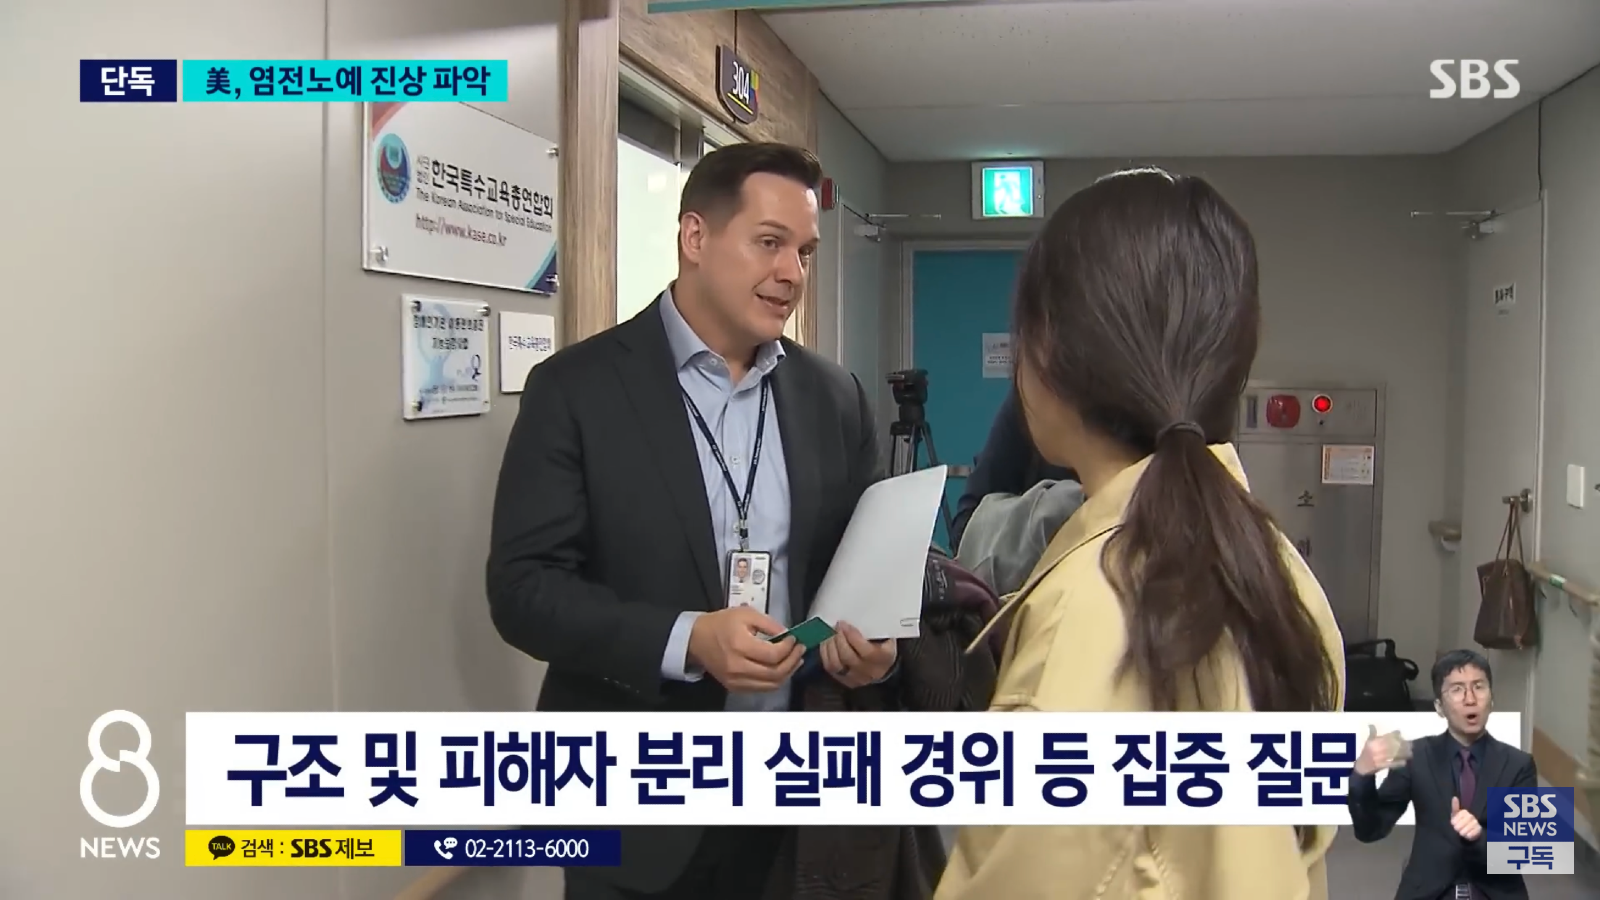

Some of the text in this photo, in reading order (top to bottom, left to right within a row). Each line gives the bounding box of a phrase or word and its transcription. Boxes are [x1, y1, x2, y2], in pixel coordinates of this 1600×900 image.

[733, 61, 749, 104] 304
[432, 159, 553, 218] 한국특수교육총연합회
[432, 193, 457, 209] Korean
[459, 200, 494, 217] Association
[415, 213, 507, 246] http://www.kase.co.kr
